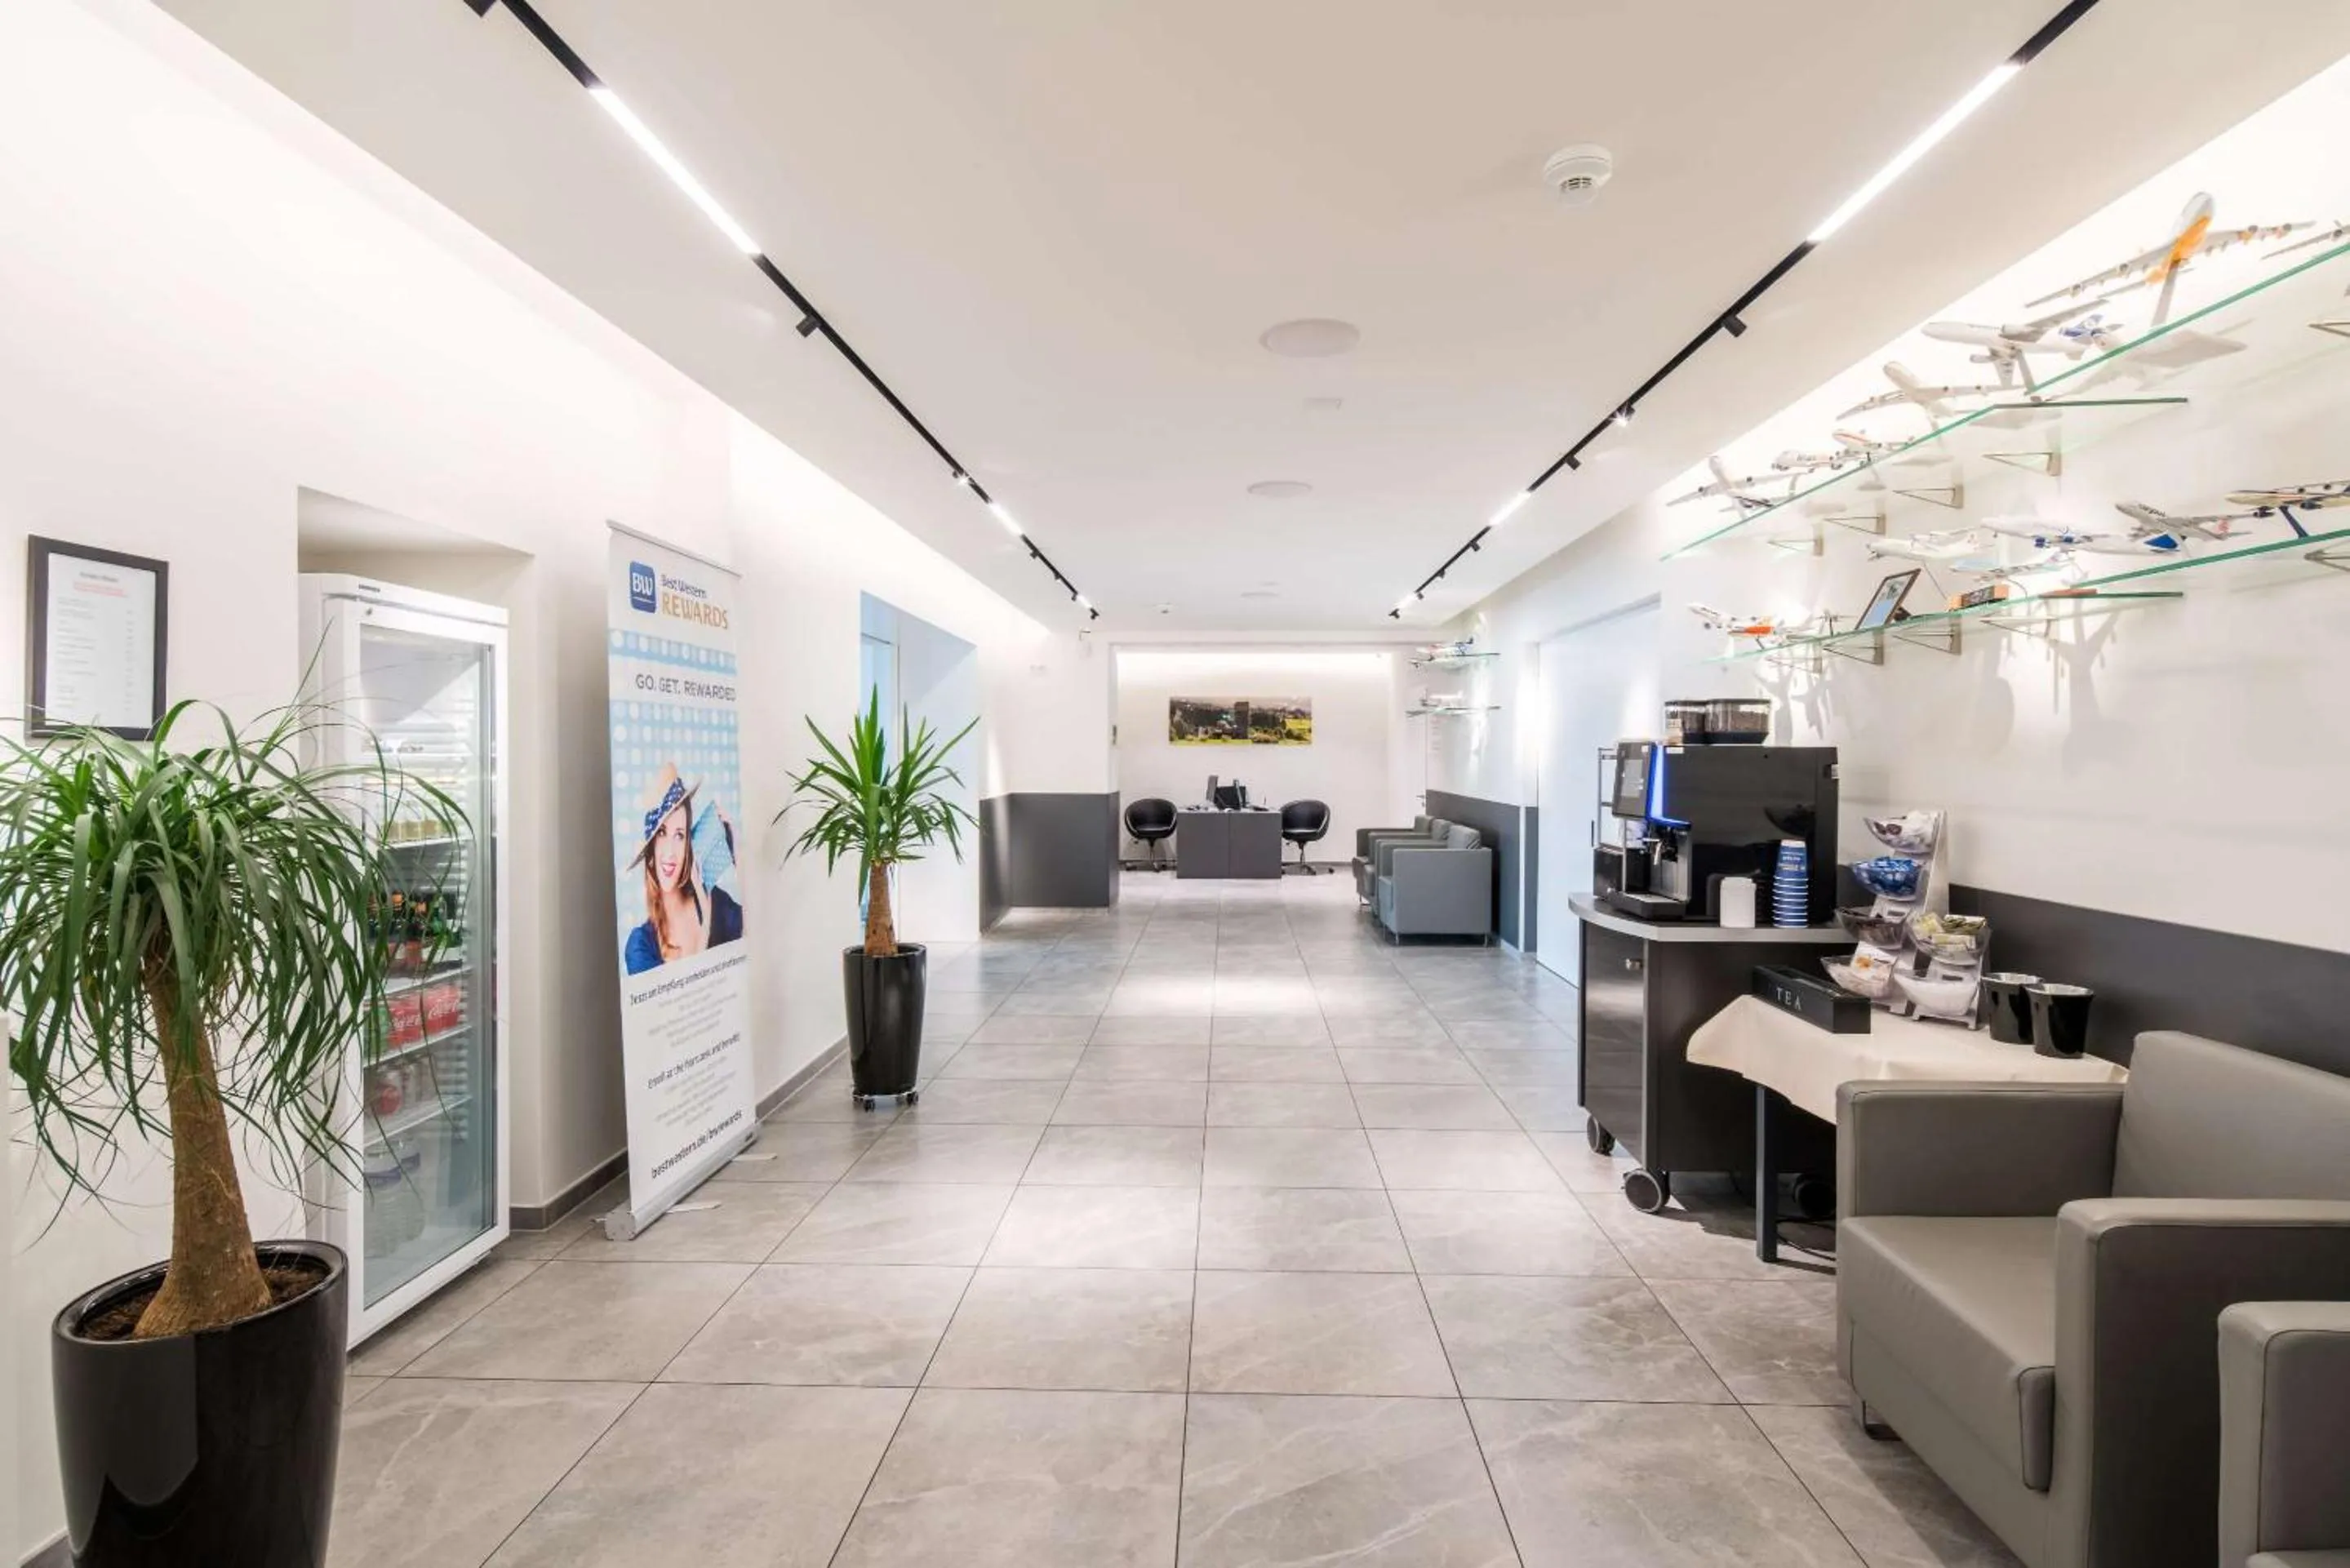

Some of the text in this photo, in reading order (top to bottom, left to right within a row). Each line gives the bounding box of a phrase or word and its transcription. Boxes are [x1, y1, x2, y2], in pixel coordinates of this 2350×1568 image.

[633, 572, 652, 596] BW
[677, 580, 708, 600] Western
[662, 591, 729, 629] REWARDS
[636, 673, 656, 691] GO.
[659, 677, 681, 695] GET.
[1775, 986, 1801, 1011] TEA
